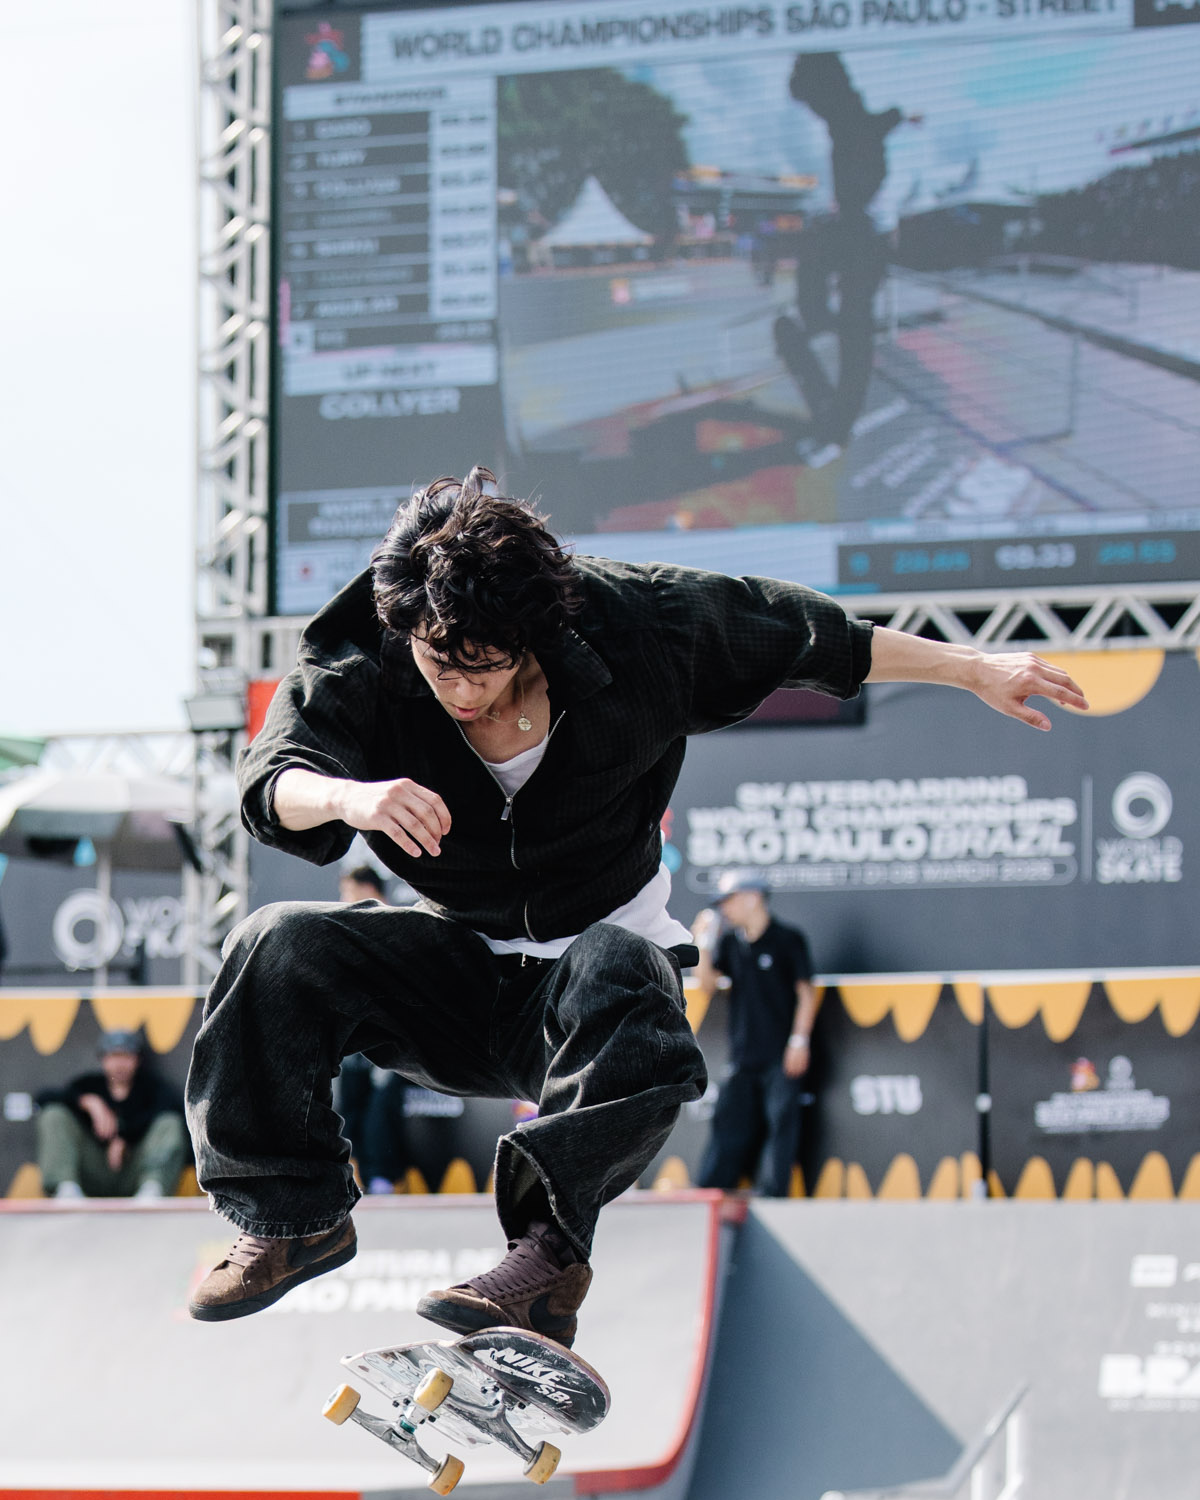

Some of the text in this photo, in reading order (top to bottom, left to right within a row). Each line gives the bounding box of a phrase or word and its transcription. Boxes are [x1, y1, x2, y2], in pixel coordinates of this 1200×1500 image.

[393, 28, 502, 60] WORLD
[512, 9, 774, 53] CHAMPIONSHIPS
[861, 0, 967, 26] PAULO
[737, 776, 1028, 806] SKATEBOARDING
[687, 797, 1077, 830] WORLD CHAMPIONSHIPS
[786, 826, 929, 864] PAULO
[930, 824, 1075, 859] BRAZIL
[1096, 837, 1183, 860] WORLD
[1096, 859, 1183, 883] SKATE
[851, 1075, 923, 1115] STU
[495, 1347, 567, 1386] NIKE
[534, 1384, 571, 1404] SB
